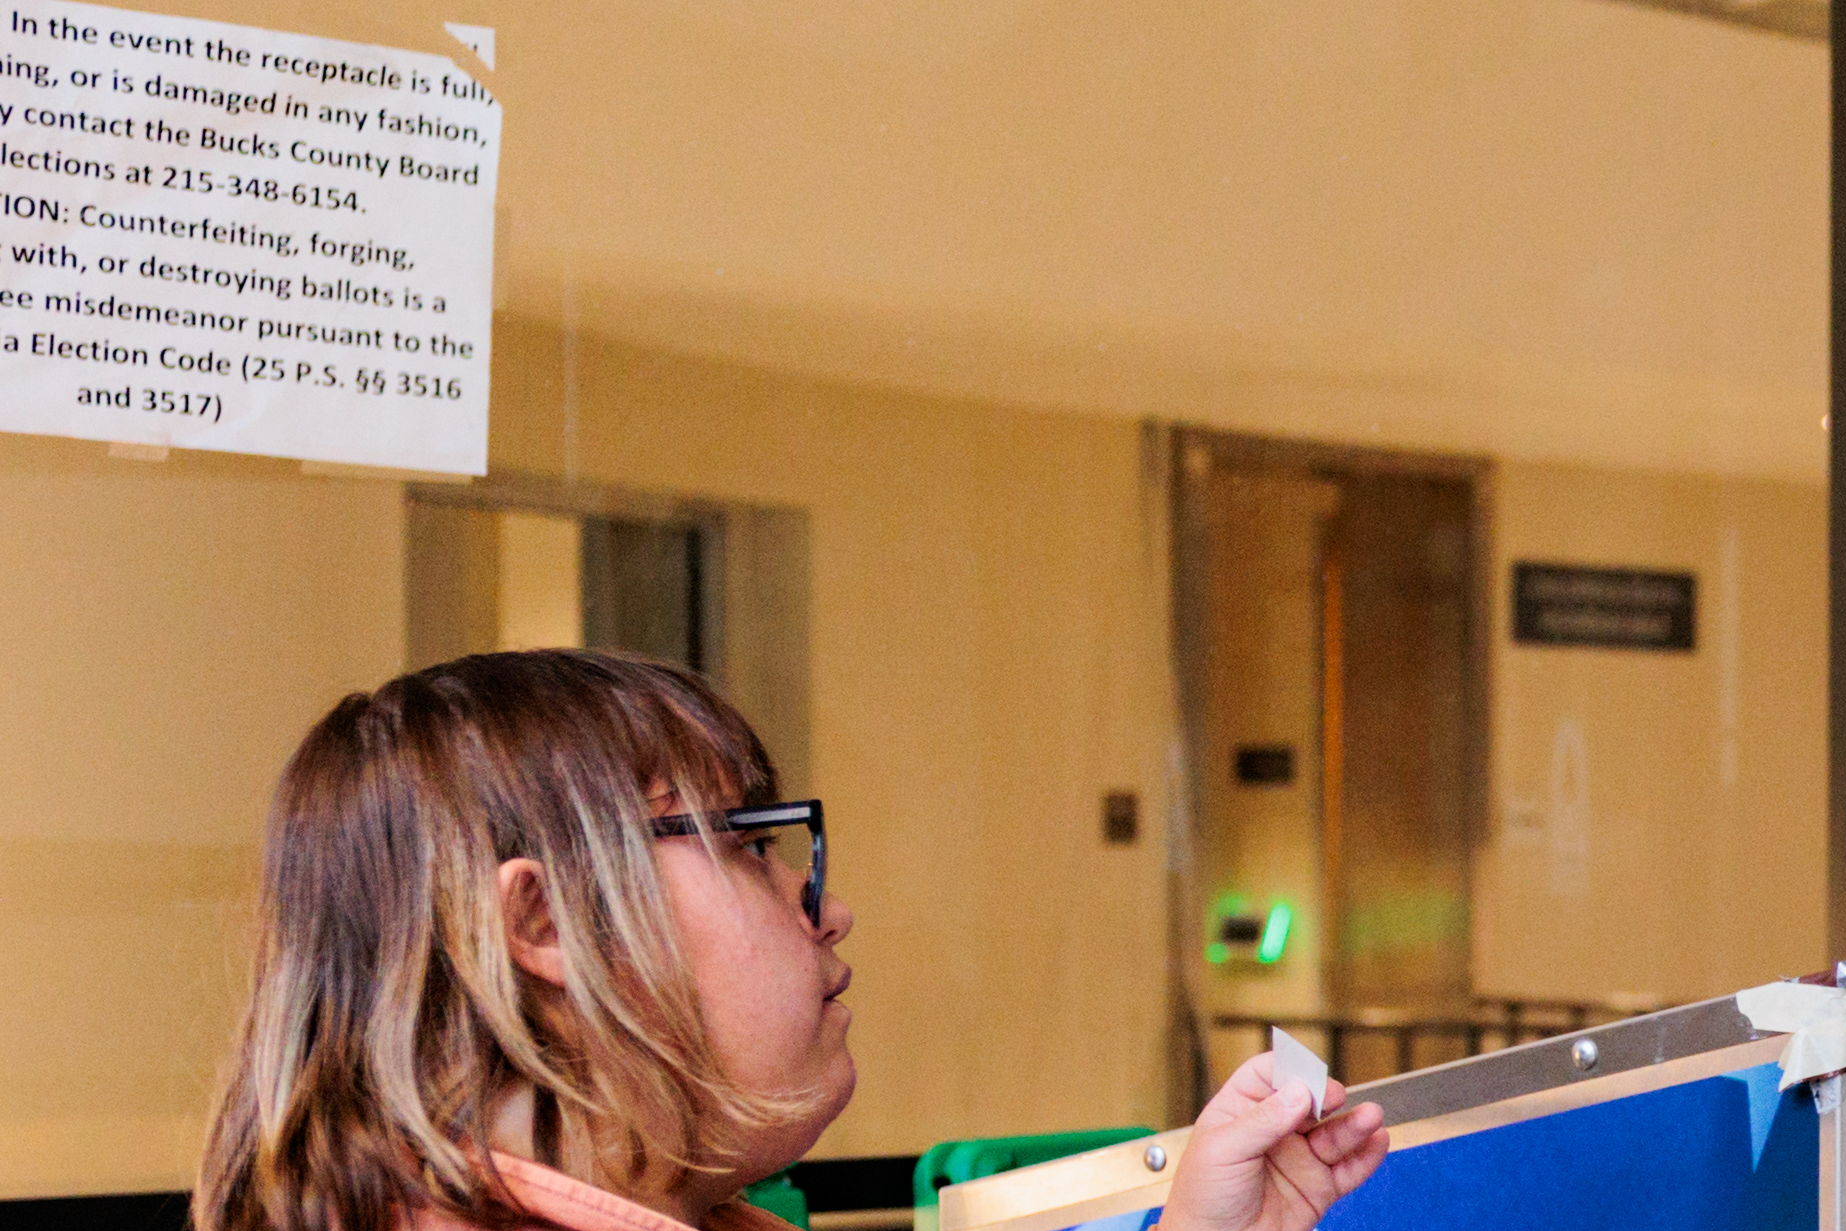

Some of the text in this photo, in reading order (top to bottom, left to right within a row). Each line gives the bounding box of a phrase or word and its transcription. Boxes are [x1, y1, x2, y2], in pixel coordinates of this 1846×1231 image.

[13, 10, 493, 106] In the event the receptacle is full,
[70, 70, 101, 88] or
[113, 68, 134, 93] is
[145, 75, 277, 115] damaged
[285, 97, 309, 119] in
[318, 107, 368, 132] any
[379, 108, 487, 148] fashion,
[24, 106, 134, 139] contact
[145, 120, 190, 147] the
[200, 127, 280, 160] Bucks
[290, 141, 391, 178] County
[399, 154, 479, 186] Board
[125, 164, 153, 185] at
[162, 167, 368, 214] 215-348-6154.
[0, 192, 415, 271] ION: Counterfeiting, forging,
[12, 243, 447, 313] with, or destroying ballots is a
[45, 291, 249, 333] misdemeanor
[258, 317, 383, 350] pursuant
[394, 330, 421, 353] to
[431, 335, 474, 360] the
[3, 333, 463, 401] a Election Code (25 P.S. §§ 3516
[77, 385, 223, 423] and 3517)
